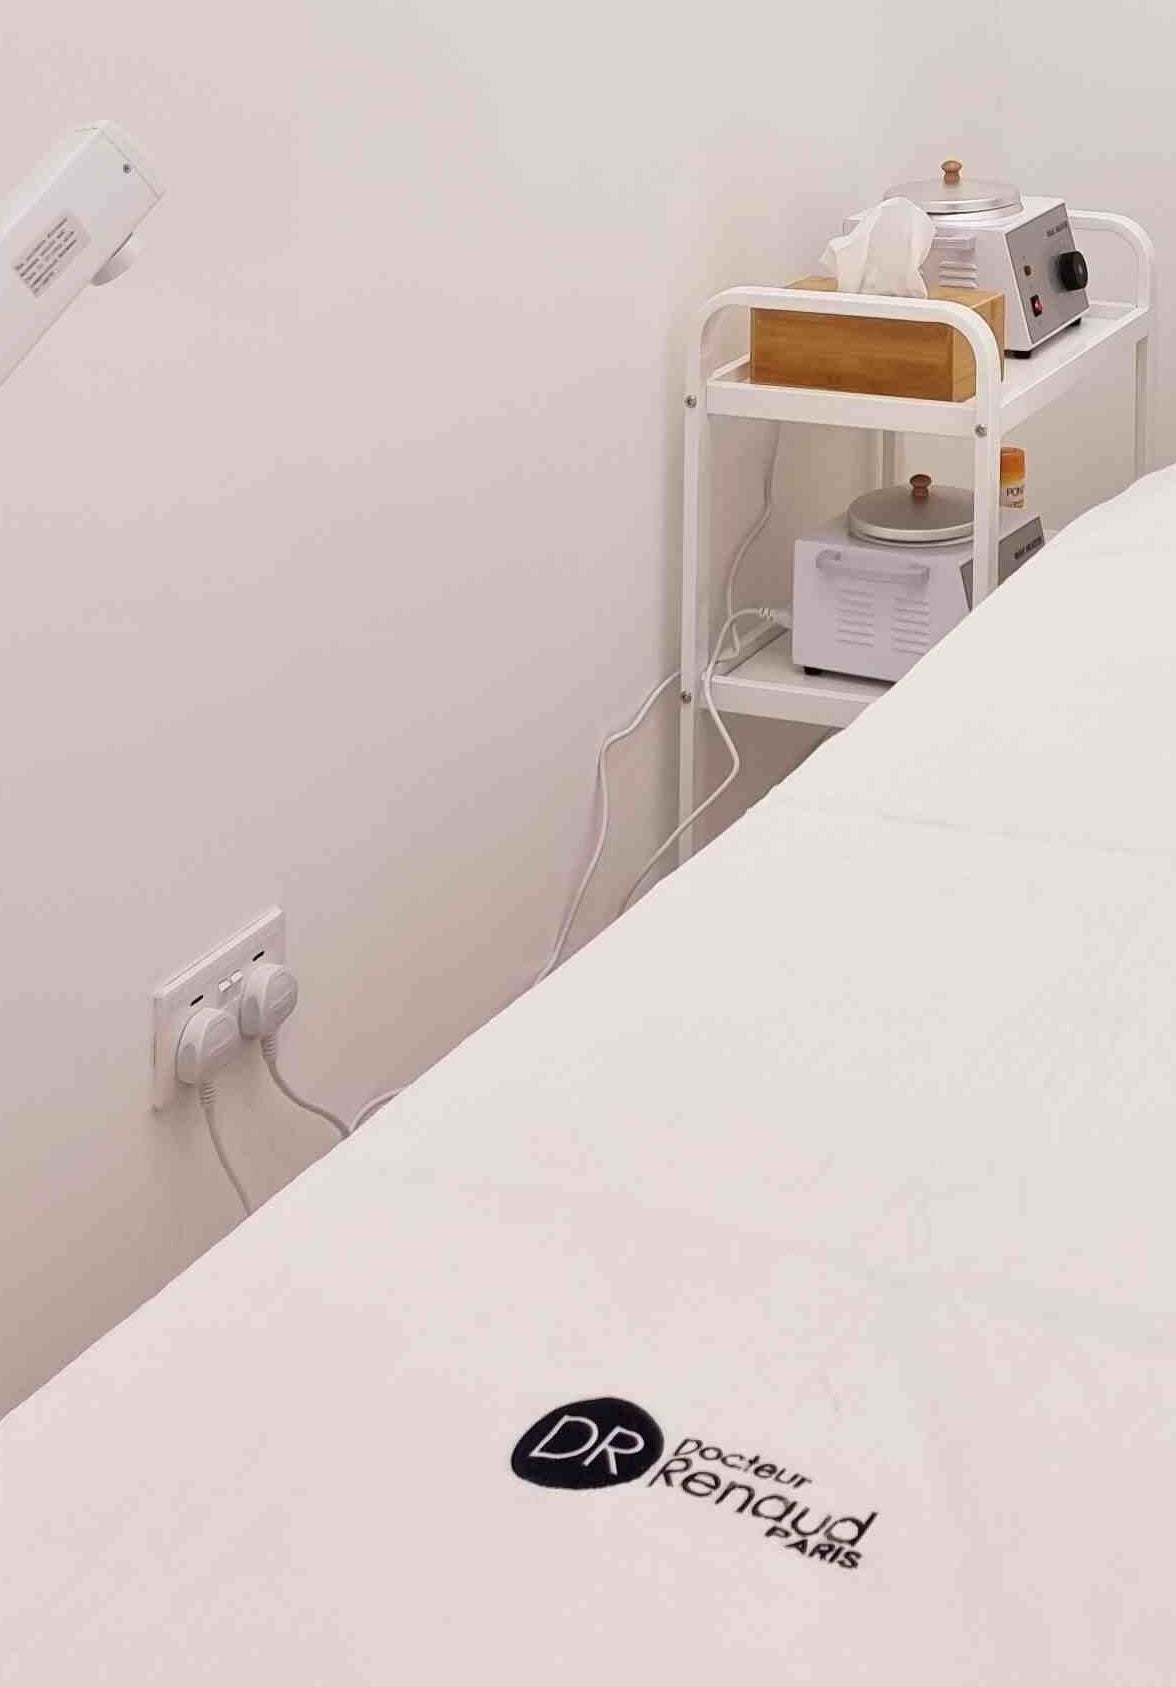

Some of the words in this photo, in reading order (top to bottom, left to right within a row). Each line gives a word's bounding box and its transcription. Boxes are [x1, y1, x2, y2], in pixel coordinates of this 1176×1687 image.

[528, 1414, 645, 1476] DR
[674, 1438, 812, 1490] Docteur
[648, 1458, 878, 1547] Renaud
[764, 1526, 863, 1570] PARIS
